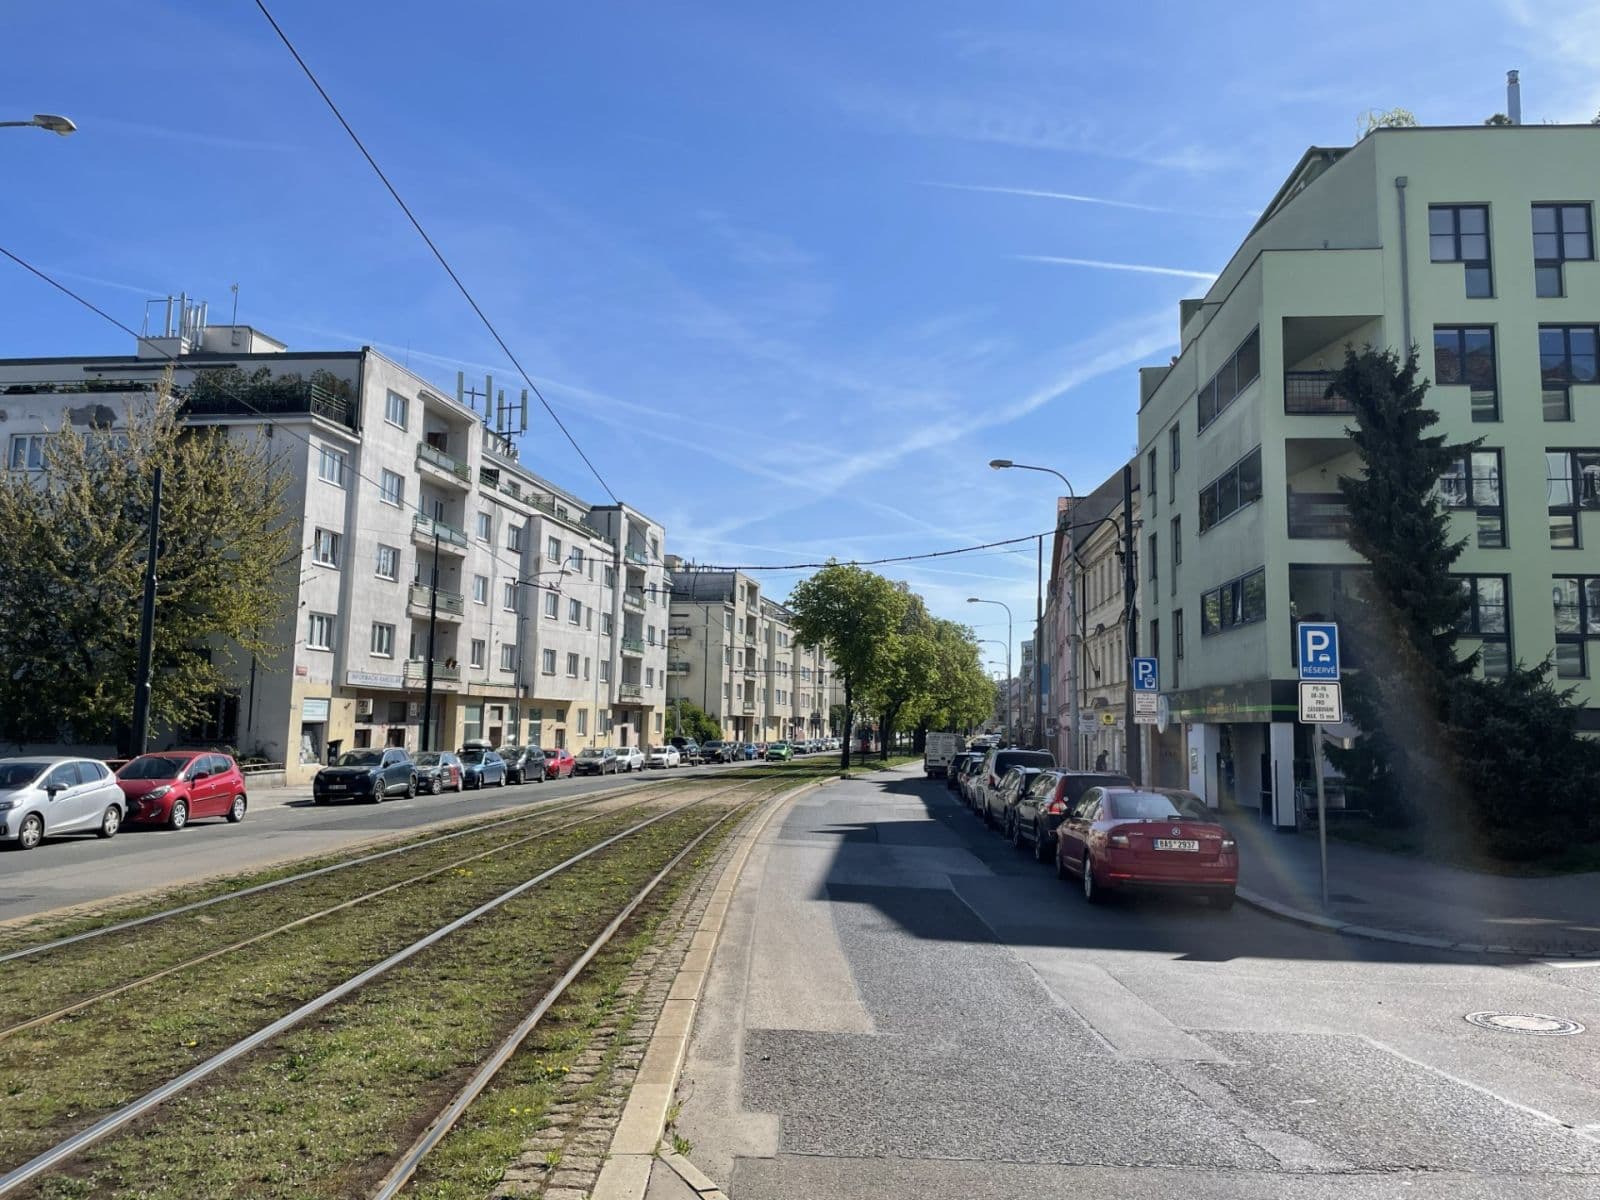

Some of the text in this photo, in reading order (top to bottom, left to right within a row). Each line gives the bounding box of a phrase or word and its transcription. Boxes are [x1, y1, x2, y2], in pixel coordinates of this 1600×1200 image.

[1307, 631, 1330, 663] P
[1138, 661, 1152, 681] P
[1303, 665, 1336, 674] RÉSERVÉ
[1178, 840, 1195, 849] 2937
